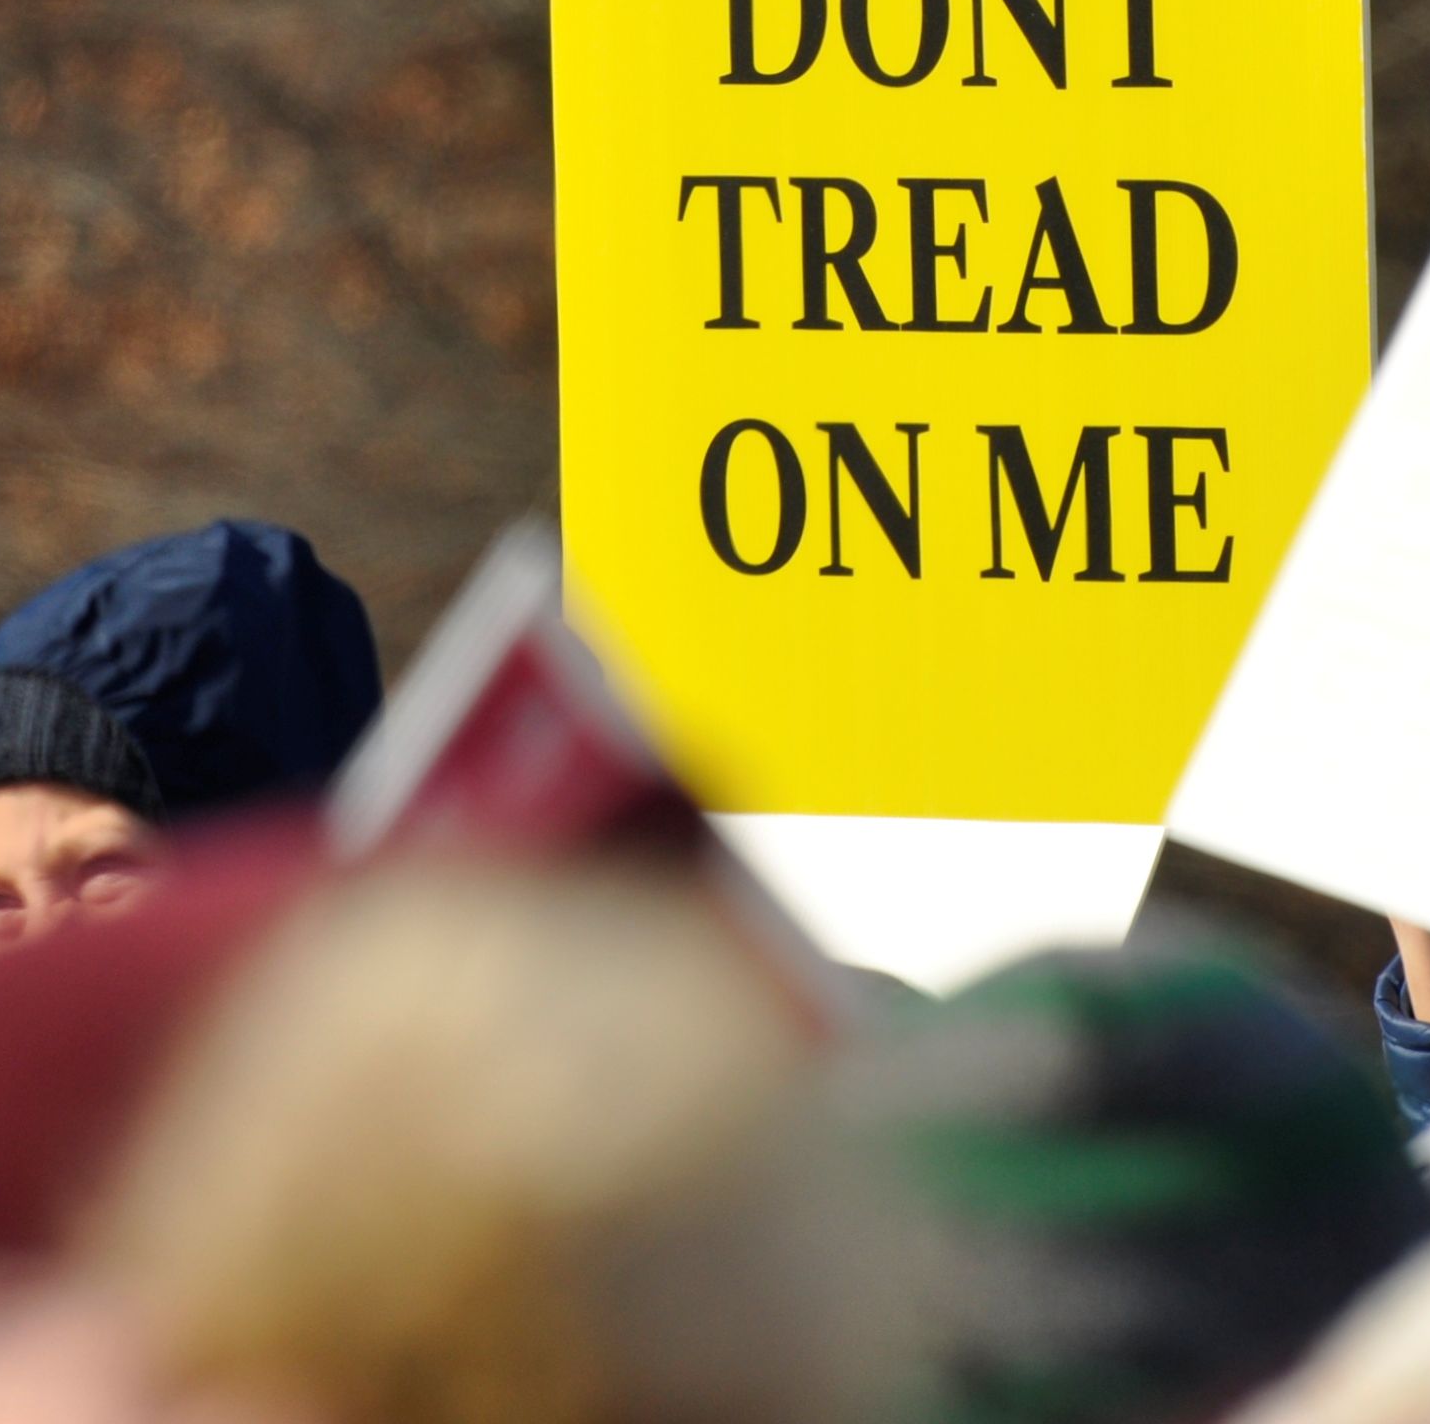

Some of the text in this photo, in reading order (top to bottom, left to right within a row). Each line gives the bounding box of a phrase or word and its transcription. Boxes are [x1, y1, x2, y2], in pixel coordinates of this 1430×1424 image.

[677, 175, 1239, 336] TREAD
[699, 417, 1235, 584] ON ME
